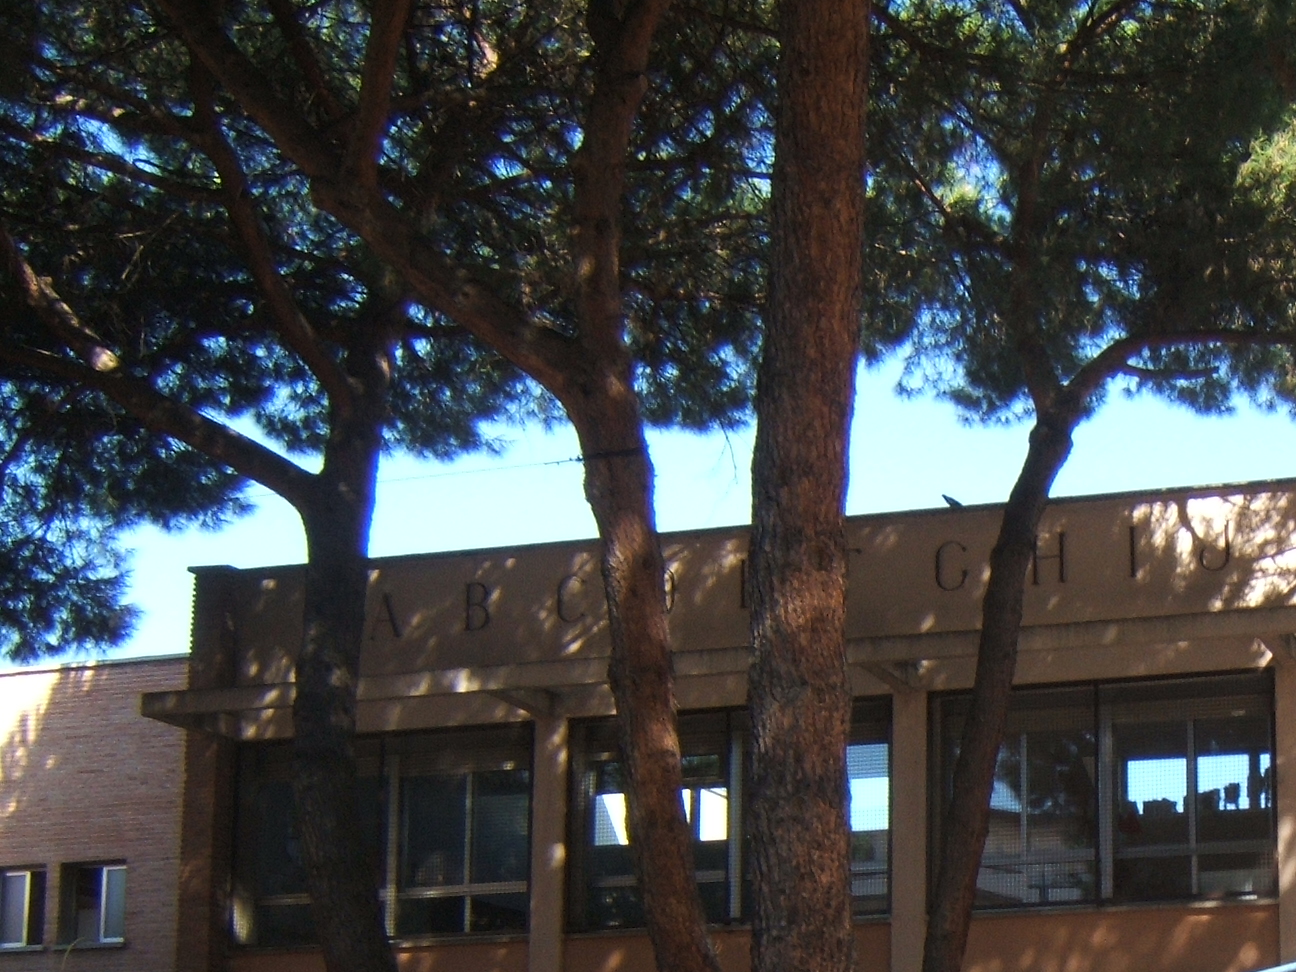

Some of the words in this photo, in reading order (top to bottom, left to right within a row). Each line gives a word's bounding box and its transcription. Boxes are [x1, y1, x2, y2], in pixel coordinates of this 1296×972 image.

[372, 592, 401, 640] A
[464, 582, 490, 631] B
[557, 575, 585, 623] C
[1031, 531, 1066, 586] H
[1129, 526, 1136, 578] I
[1199, 519, 1230, 571] J
